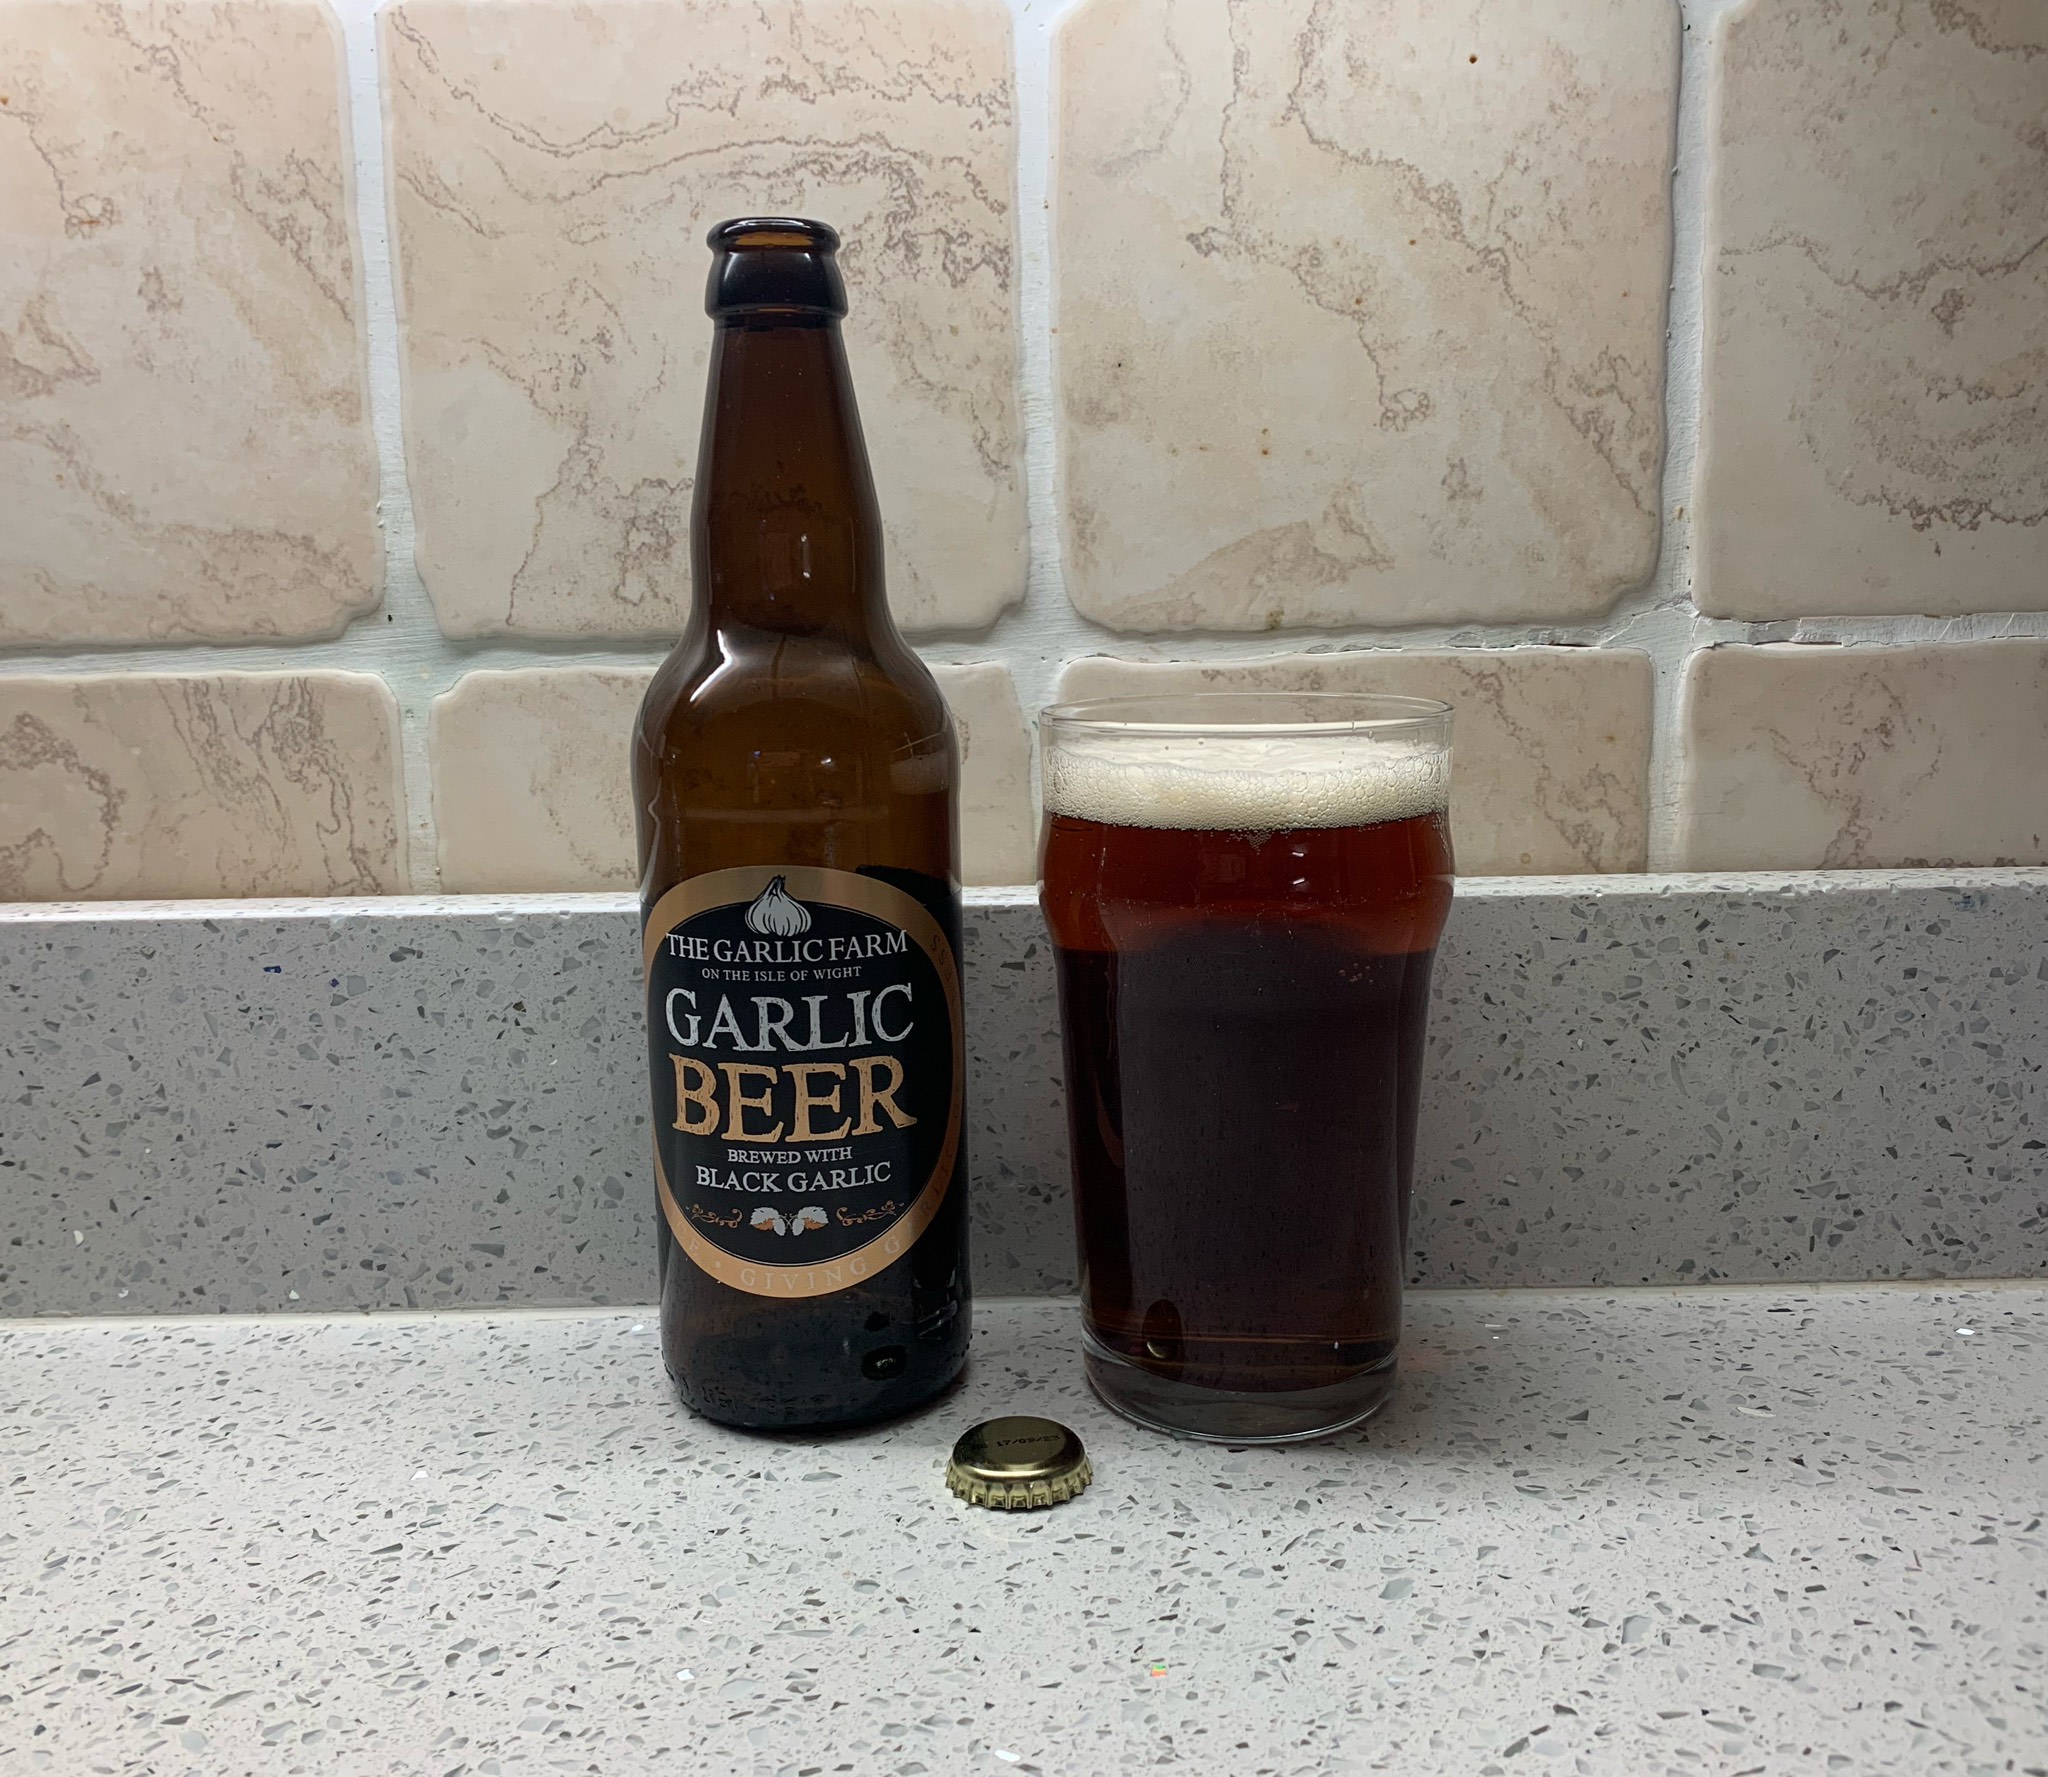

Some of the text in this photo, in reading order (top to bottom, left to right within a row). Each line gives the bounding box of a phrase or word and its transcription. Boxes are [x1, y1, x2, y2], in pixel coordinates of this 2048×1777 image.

[666, 929, 908, 963] THE GARLIC FARM
[701, 966, 862, 982] ON THE ISLE OF WIGHT
[665, 982, 914, 1052] GARLIC
[668, 1052, 918, 1143] BEER
[727, 1146, 853, 1164] BREWED WITH
[695, 1161, 892, 1193] BLACK GARLIC
[740, 1256, 867, 1291] GIVING
